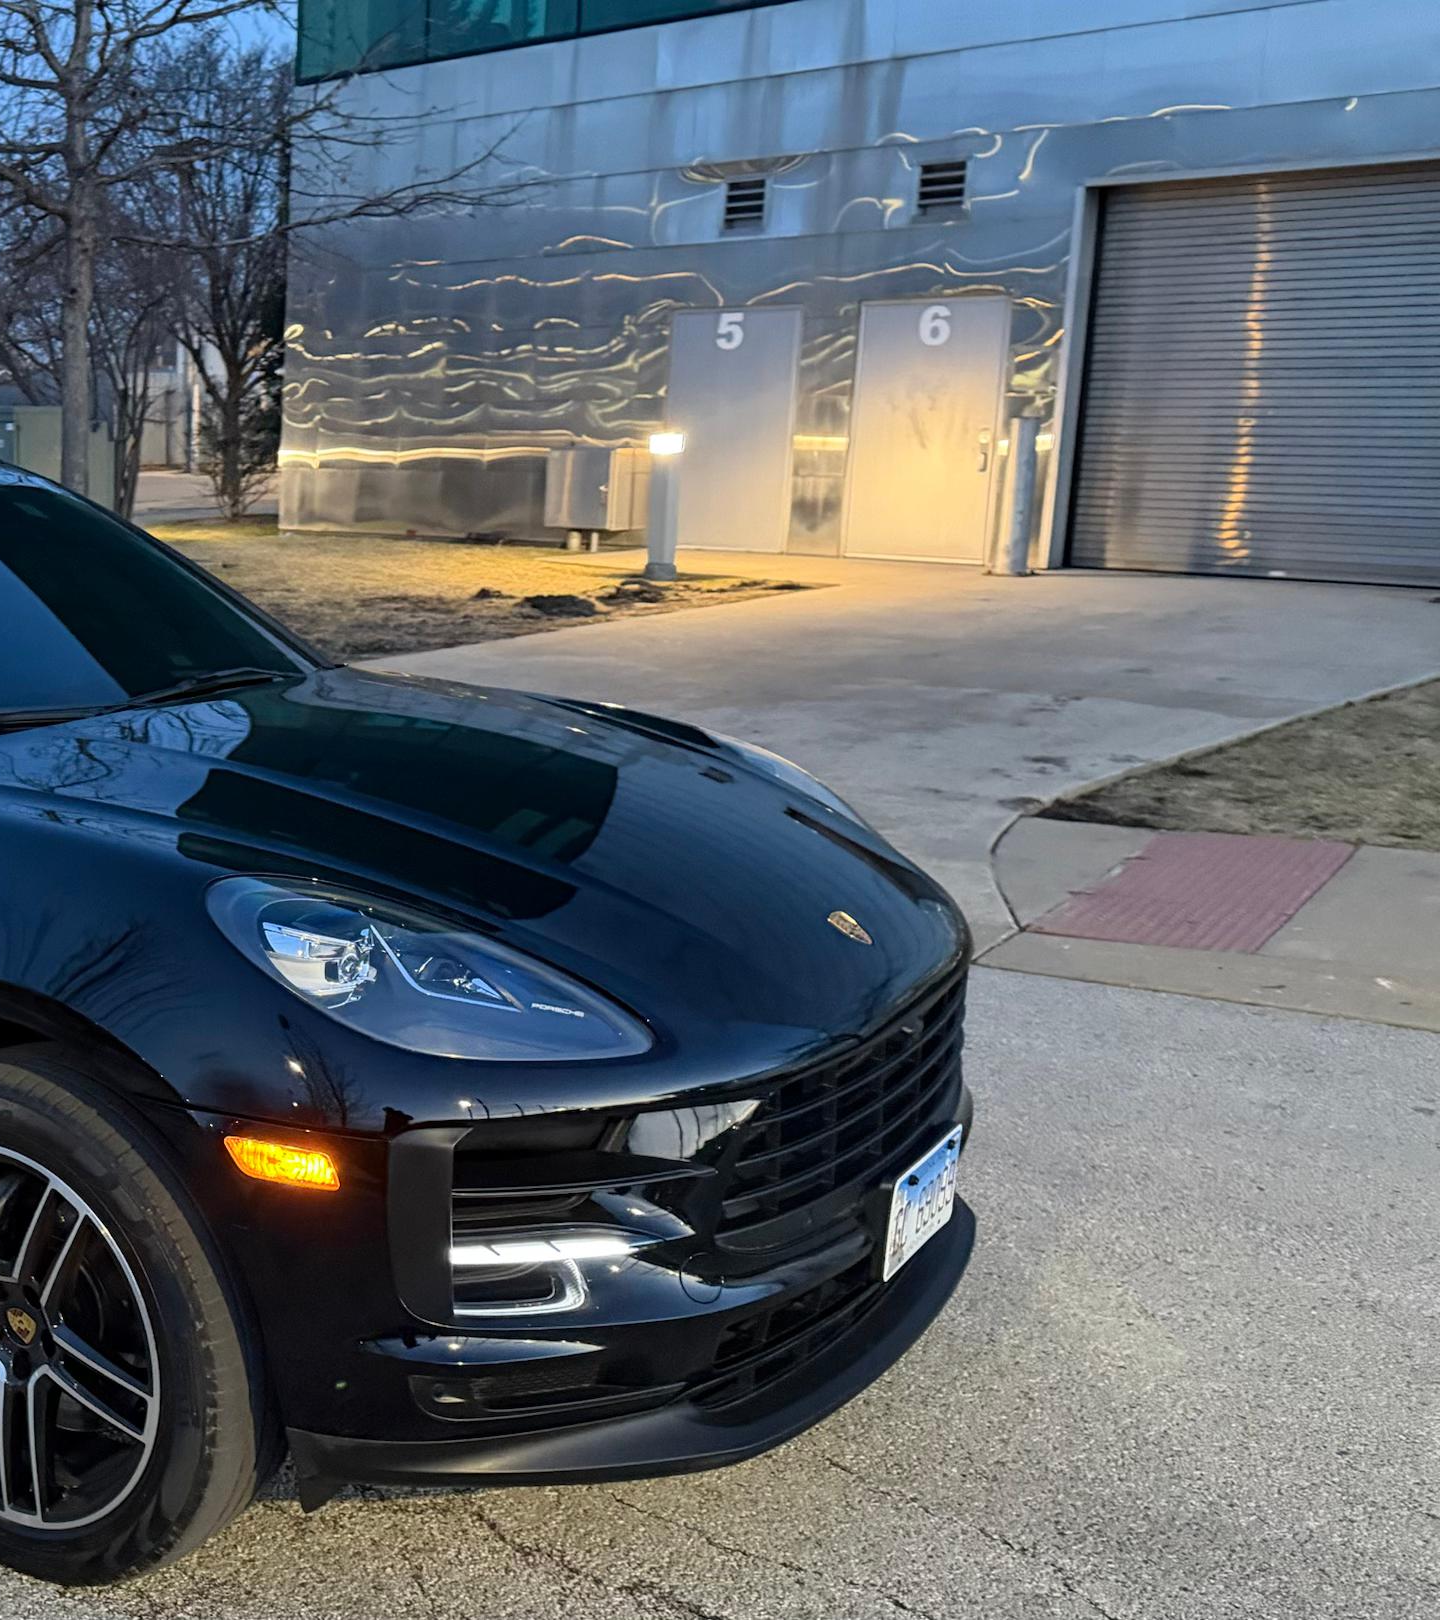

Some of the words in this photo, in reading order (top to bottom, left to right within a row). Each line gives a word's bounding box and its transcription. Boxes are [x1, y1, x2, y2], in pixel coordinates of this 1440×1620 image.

[716, 312, 744, 350] 5
[919, 305, 952, 346] 6
[531, 1003, 585, 1017] PORSCHE
